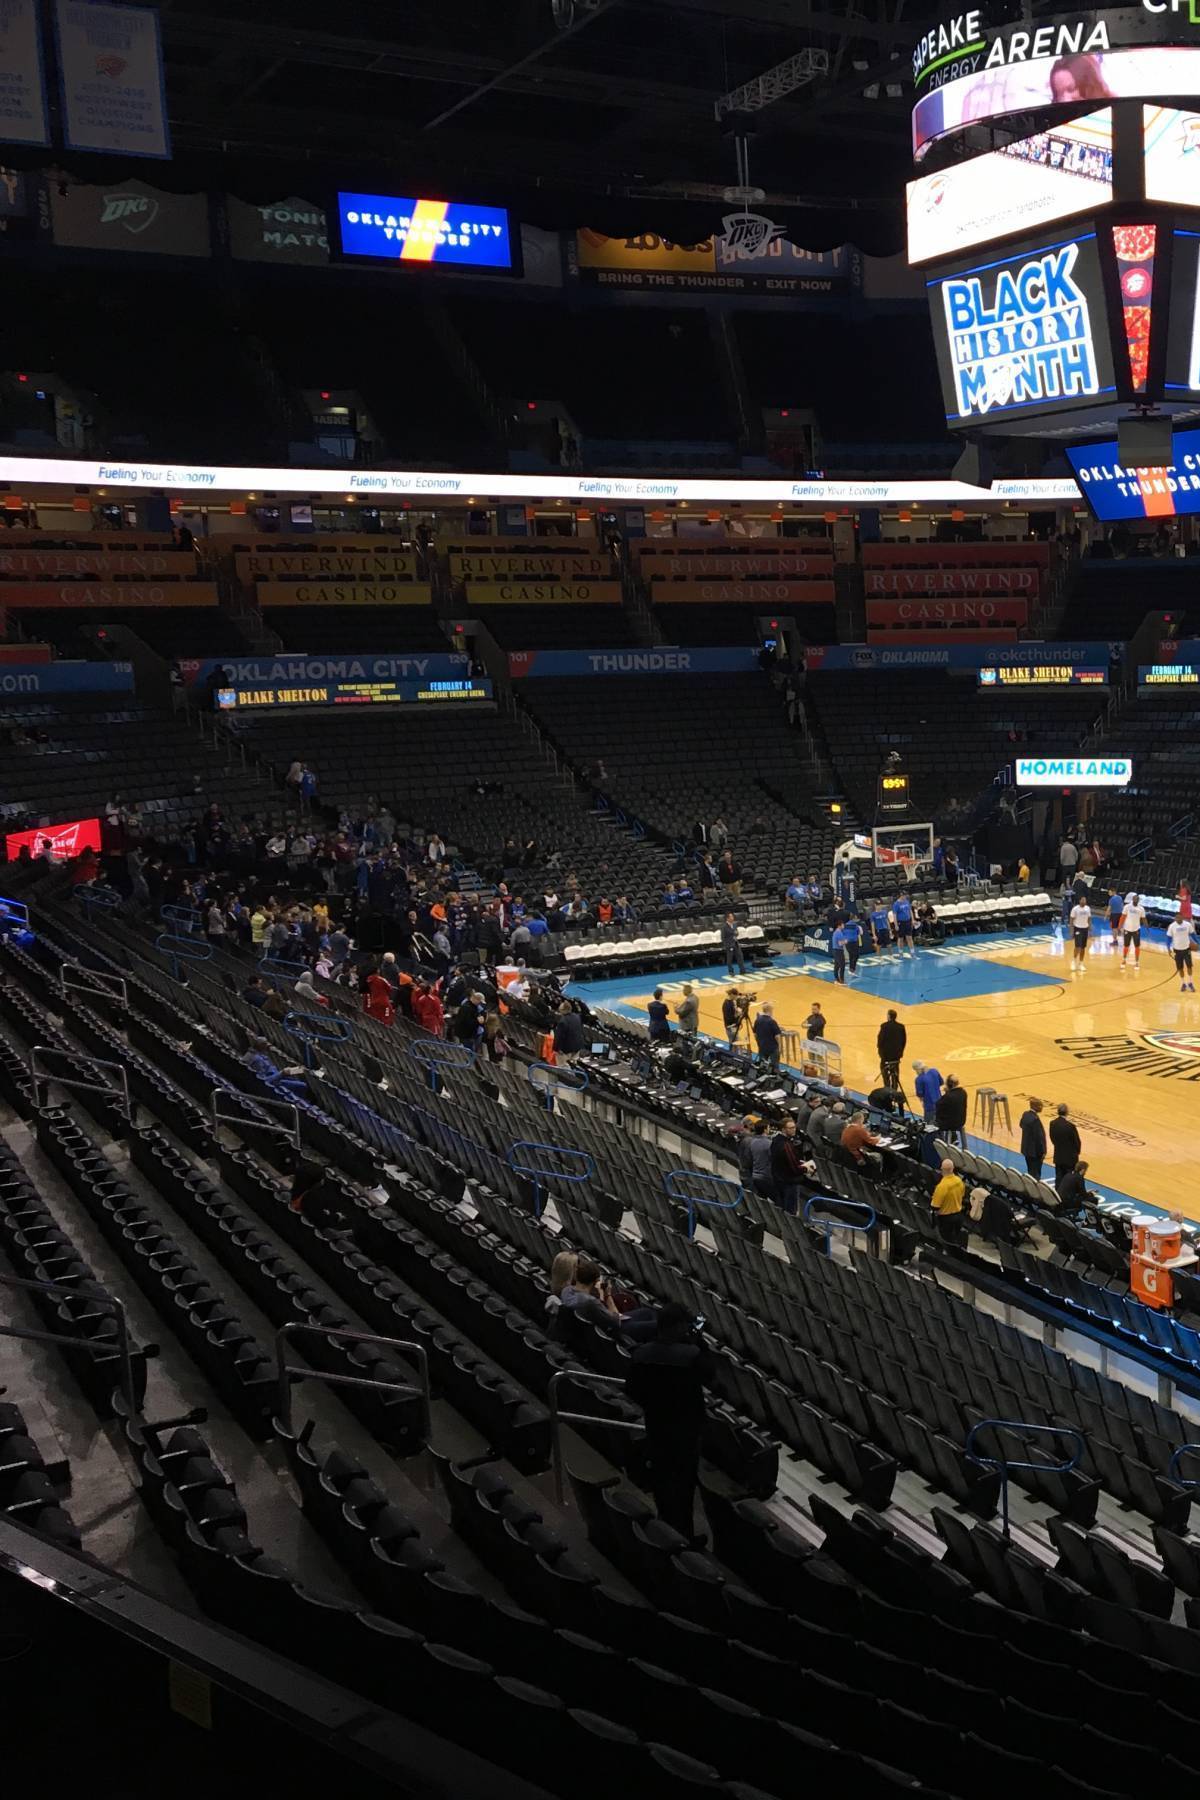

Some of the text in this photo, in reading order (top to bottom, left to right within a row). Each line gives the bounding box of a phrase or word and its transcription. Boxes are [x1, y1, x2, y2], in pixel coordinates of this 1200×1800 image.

[929, 21, 1111, 90] ENERGY ARENA
[347, 211, 503, 237] OKLAHOMA CITY
[383, 228, 471, 247] THUNDER
[598, 273, 832, 291] BRING THE THUNDER EXIT NOW
[949, 247, 1078, 330] BLACK
[956, 309, 1081, 364] HISTORY
[98, 466, 216, 487] Fueling Your Economy
[350, 474, 387, 490] Fueling
[415, 477, 461, 492] Economy
[578, 481, 612, 497] Fueling
[636, 482, 678, 497] Economy
[792, 484, 823, 499] Fueling
[848, 484, 889, 498] Economy
[997, 483, 1028, 499] Fueling
[0, 556, 167, 571] RIVERWIND
[248, 557, 407, 572] RIVERWIND
[460, 557, 602, 572] RIVERWIND
[669, 558, 808, 573] RIVERWIND
[872, 572, 1033, 591] RIVERWIND
[61, 588, 164, 603] CASINO
[296, 587, 397, 601] CASINO
[500, 586, 590, 600] CASINO
[701, 584, 789, 598] CASINO
[898, 602, 996, 618] CASINO
[449, 655, 467, 664] 120
[511, 652, 528, 662] 101
[752, 648, 761, 657] 10
[806, 648, 824, 656] 102
[855, 650, 949, 664] FOX OKLAHOMA
[987, 647, 1087, 662] @okcthunder
[113, 662, 132, 672] 119
[588, 653, 691, 672] THUNDER
[222, 659, 429, 682] OKLAHOMA CITY
[1000, 667, 1031, 679] BLAKE
[1034, 666, 1073, 678] SHELTON
[1152, 666, 1192, 675] FEBRUARY 14
[430, 681, 472, 691] FEBRUARY 14
[238, 691, 275, 705] BLAKE
[278, 688, 328, 702] SHELTON
[1020, 761, 1127, 775] HOMELAND
[925, 934, 1057, 957] THUNDER
[1143, 1268, 1157, 1293] G
